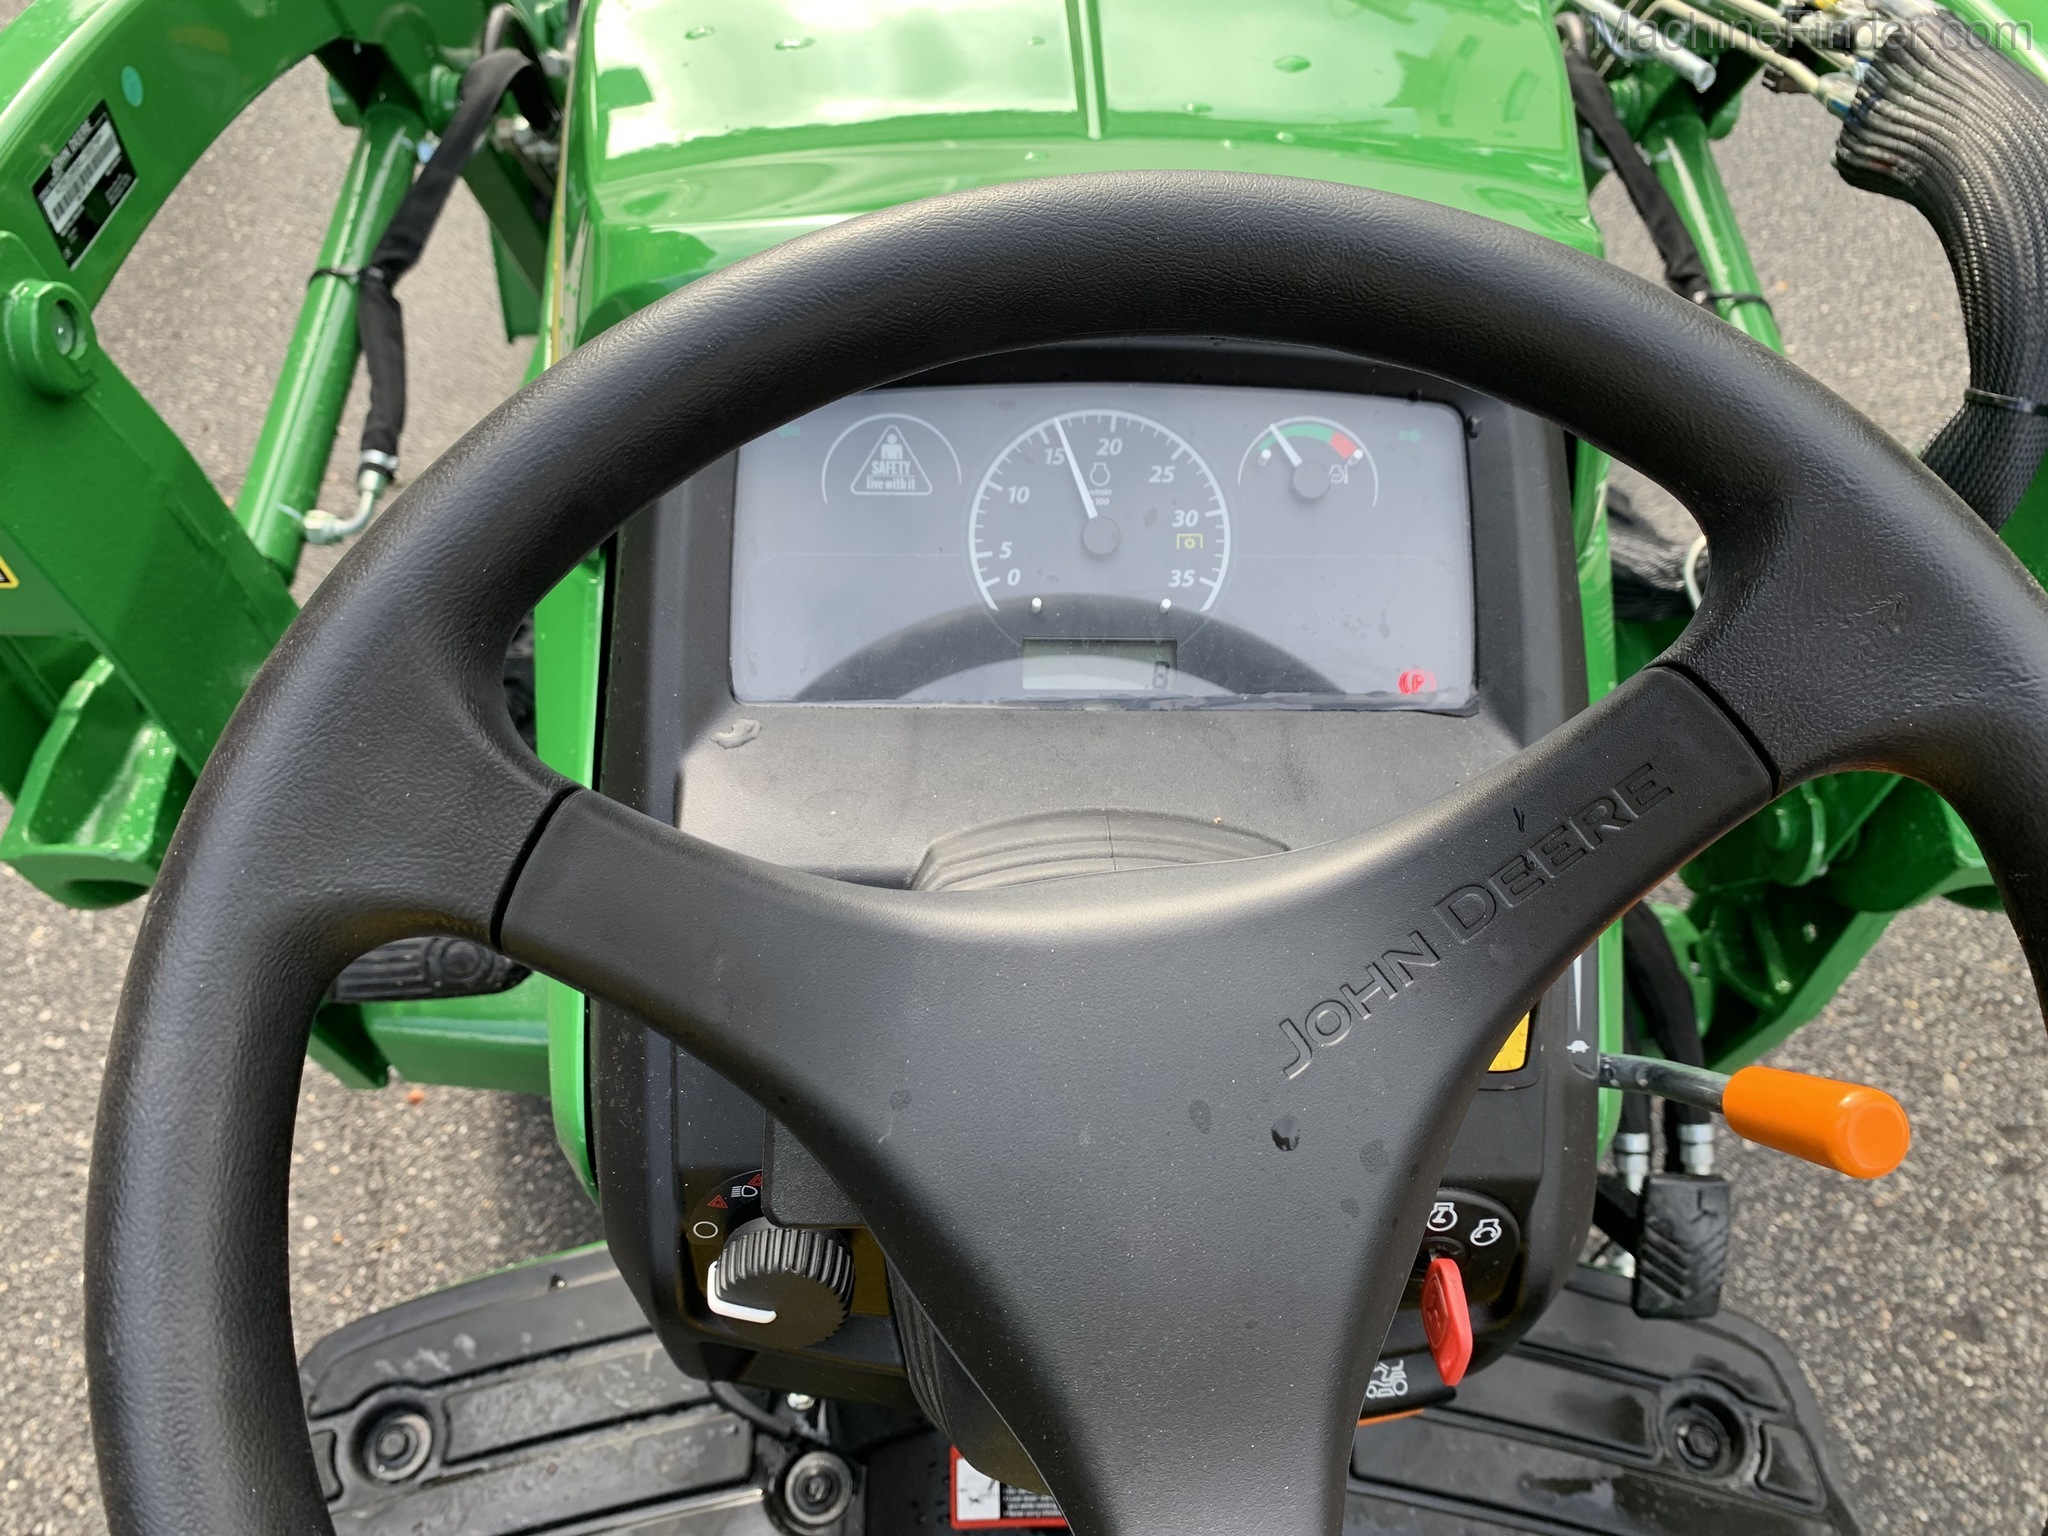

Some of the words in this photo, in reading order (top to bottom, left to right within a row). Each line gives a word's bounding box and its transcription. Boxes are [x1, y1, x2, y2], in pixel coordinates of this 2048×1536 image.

[1045, 447, 1065, 465] 15
[1096, 438, 1123, 456] 20
[872, 460, 911, 475] SAFETY
[1148, 465, 1175, 483] 25
[866, 475, 884, 490] live
[885, 475, 906, 490] with
[908, 475, 916, 490] it
[1008, 485, 1031, 504] 10
[1172, 509, 1199, 527] 30
[999, 541, 1013, 559] 5
[1007, 568, 1021, 586] 0
[1168, 569, 1196, 587] 35
[1279, 930, 1440, 1079] JOHN
[1435, 763, 1674, 944] DEERE
